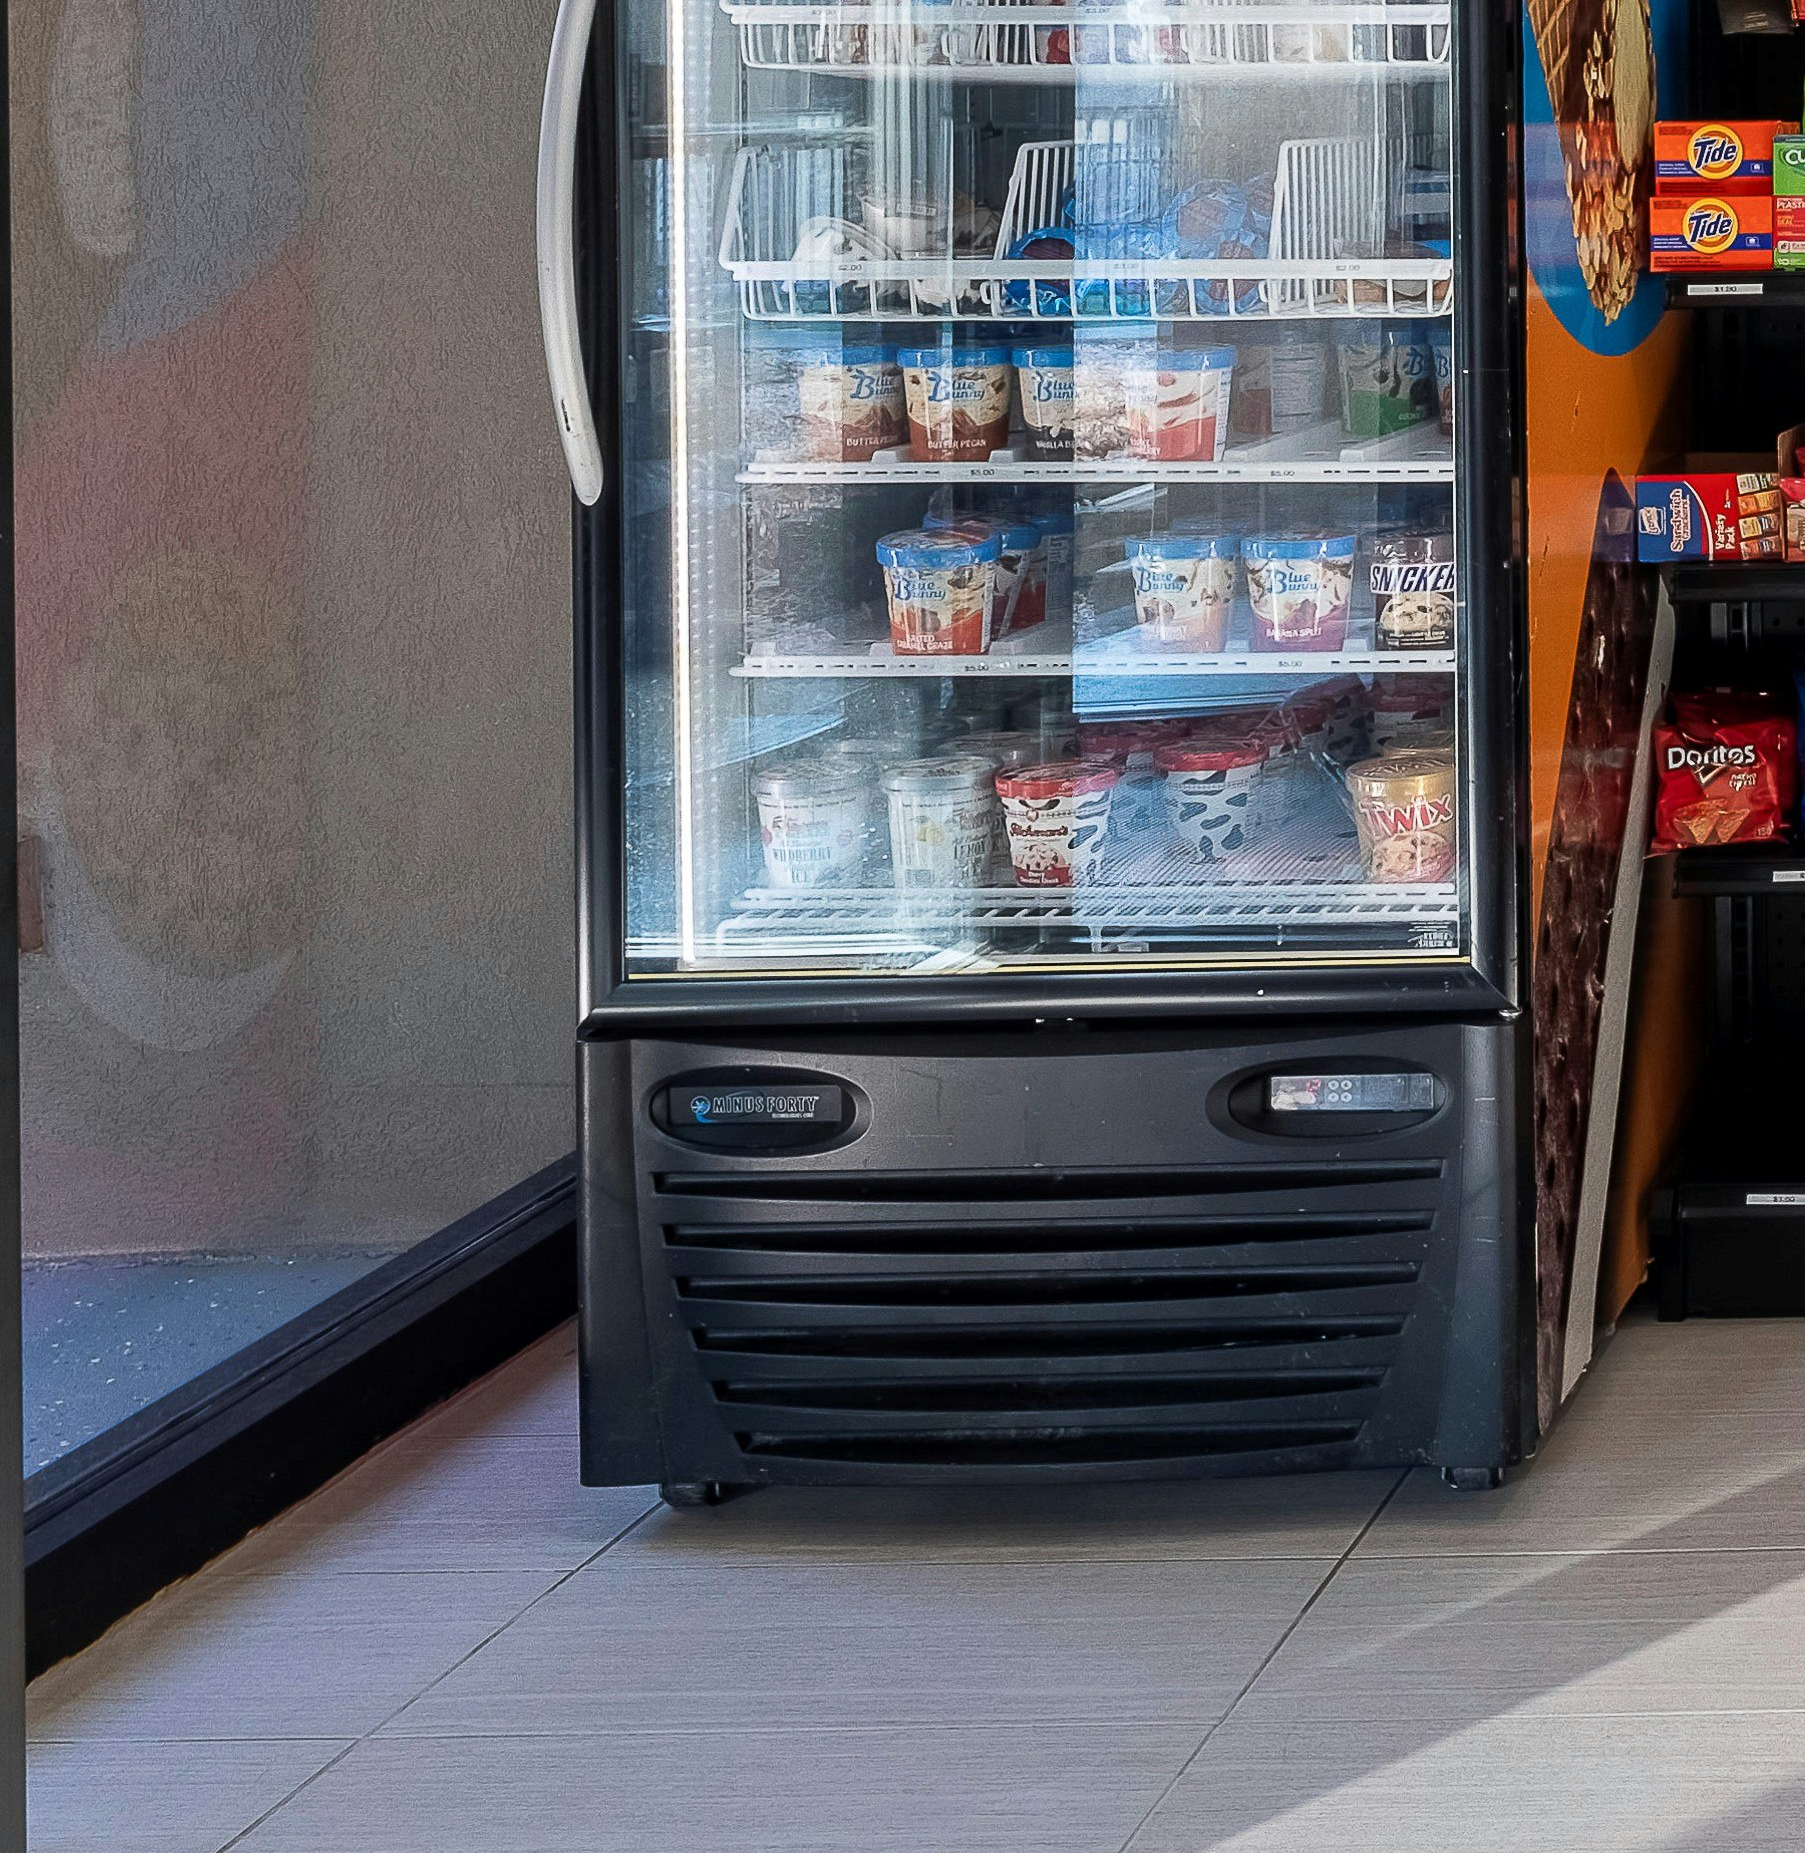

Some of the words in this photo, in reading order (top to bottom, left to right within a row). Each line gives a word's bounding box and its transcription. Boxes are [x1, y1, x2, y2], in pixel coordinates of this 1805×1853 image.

[1693, 136, 1738, 169] Tide
[961, 439, 986, 447] PECAN
[1670, 488, 1683, 552] Sandwich
[1715, 514, 1727, 550] Variety
[1667, 742, 1755, 771] Doritos
[713, 1096, 765, 1113] MINUS
[767, 1096, 817, 1113] FORTY
